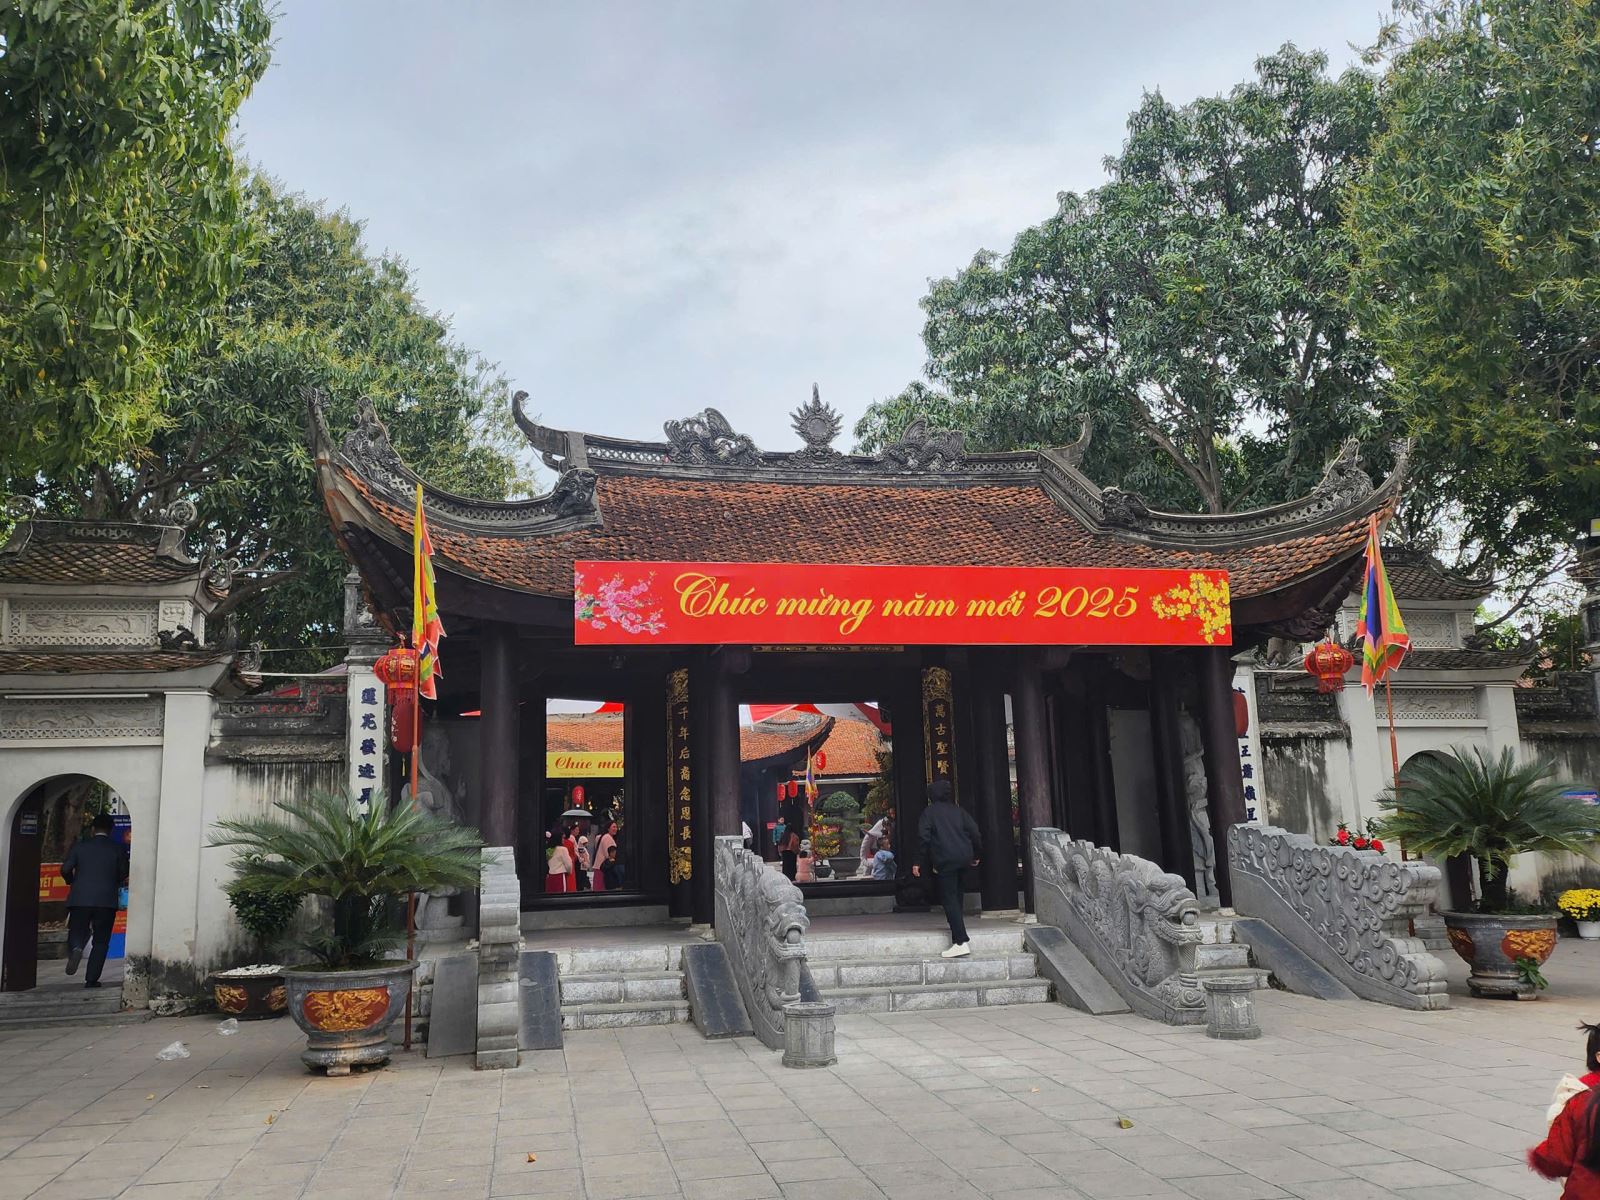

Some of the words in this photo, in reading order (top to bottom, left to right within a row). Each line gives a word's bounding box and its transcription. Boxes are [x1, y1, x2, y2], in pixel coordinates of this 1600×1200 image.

[673, 572, 768, 618] Chúc
[775, 587, 874, 635] mừng
[881, 591, 958, 617] năm
[965, 590, 1026, 617] mới
[1033, 585, 1140, 618] 2025
